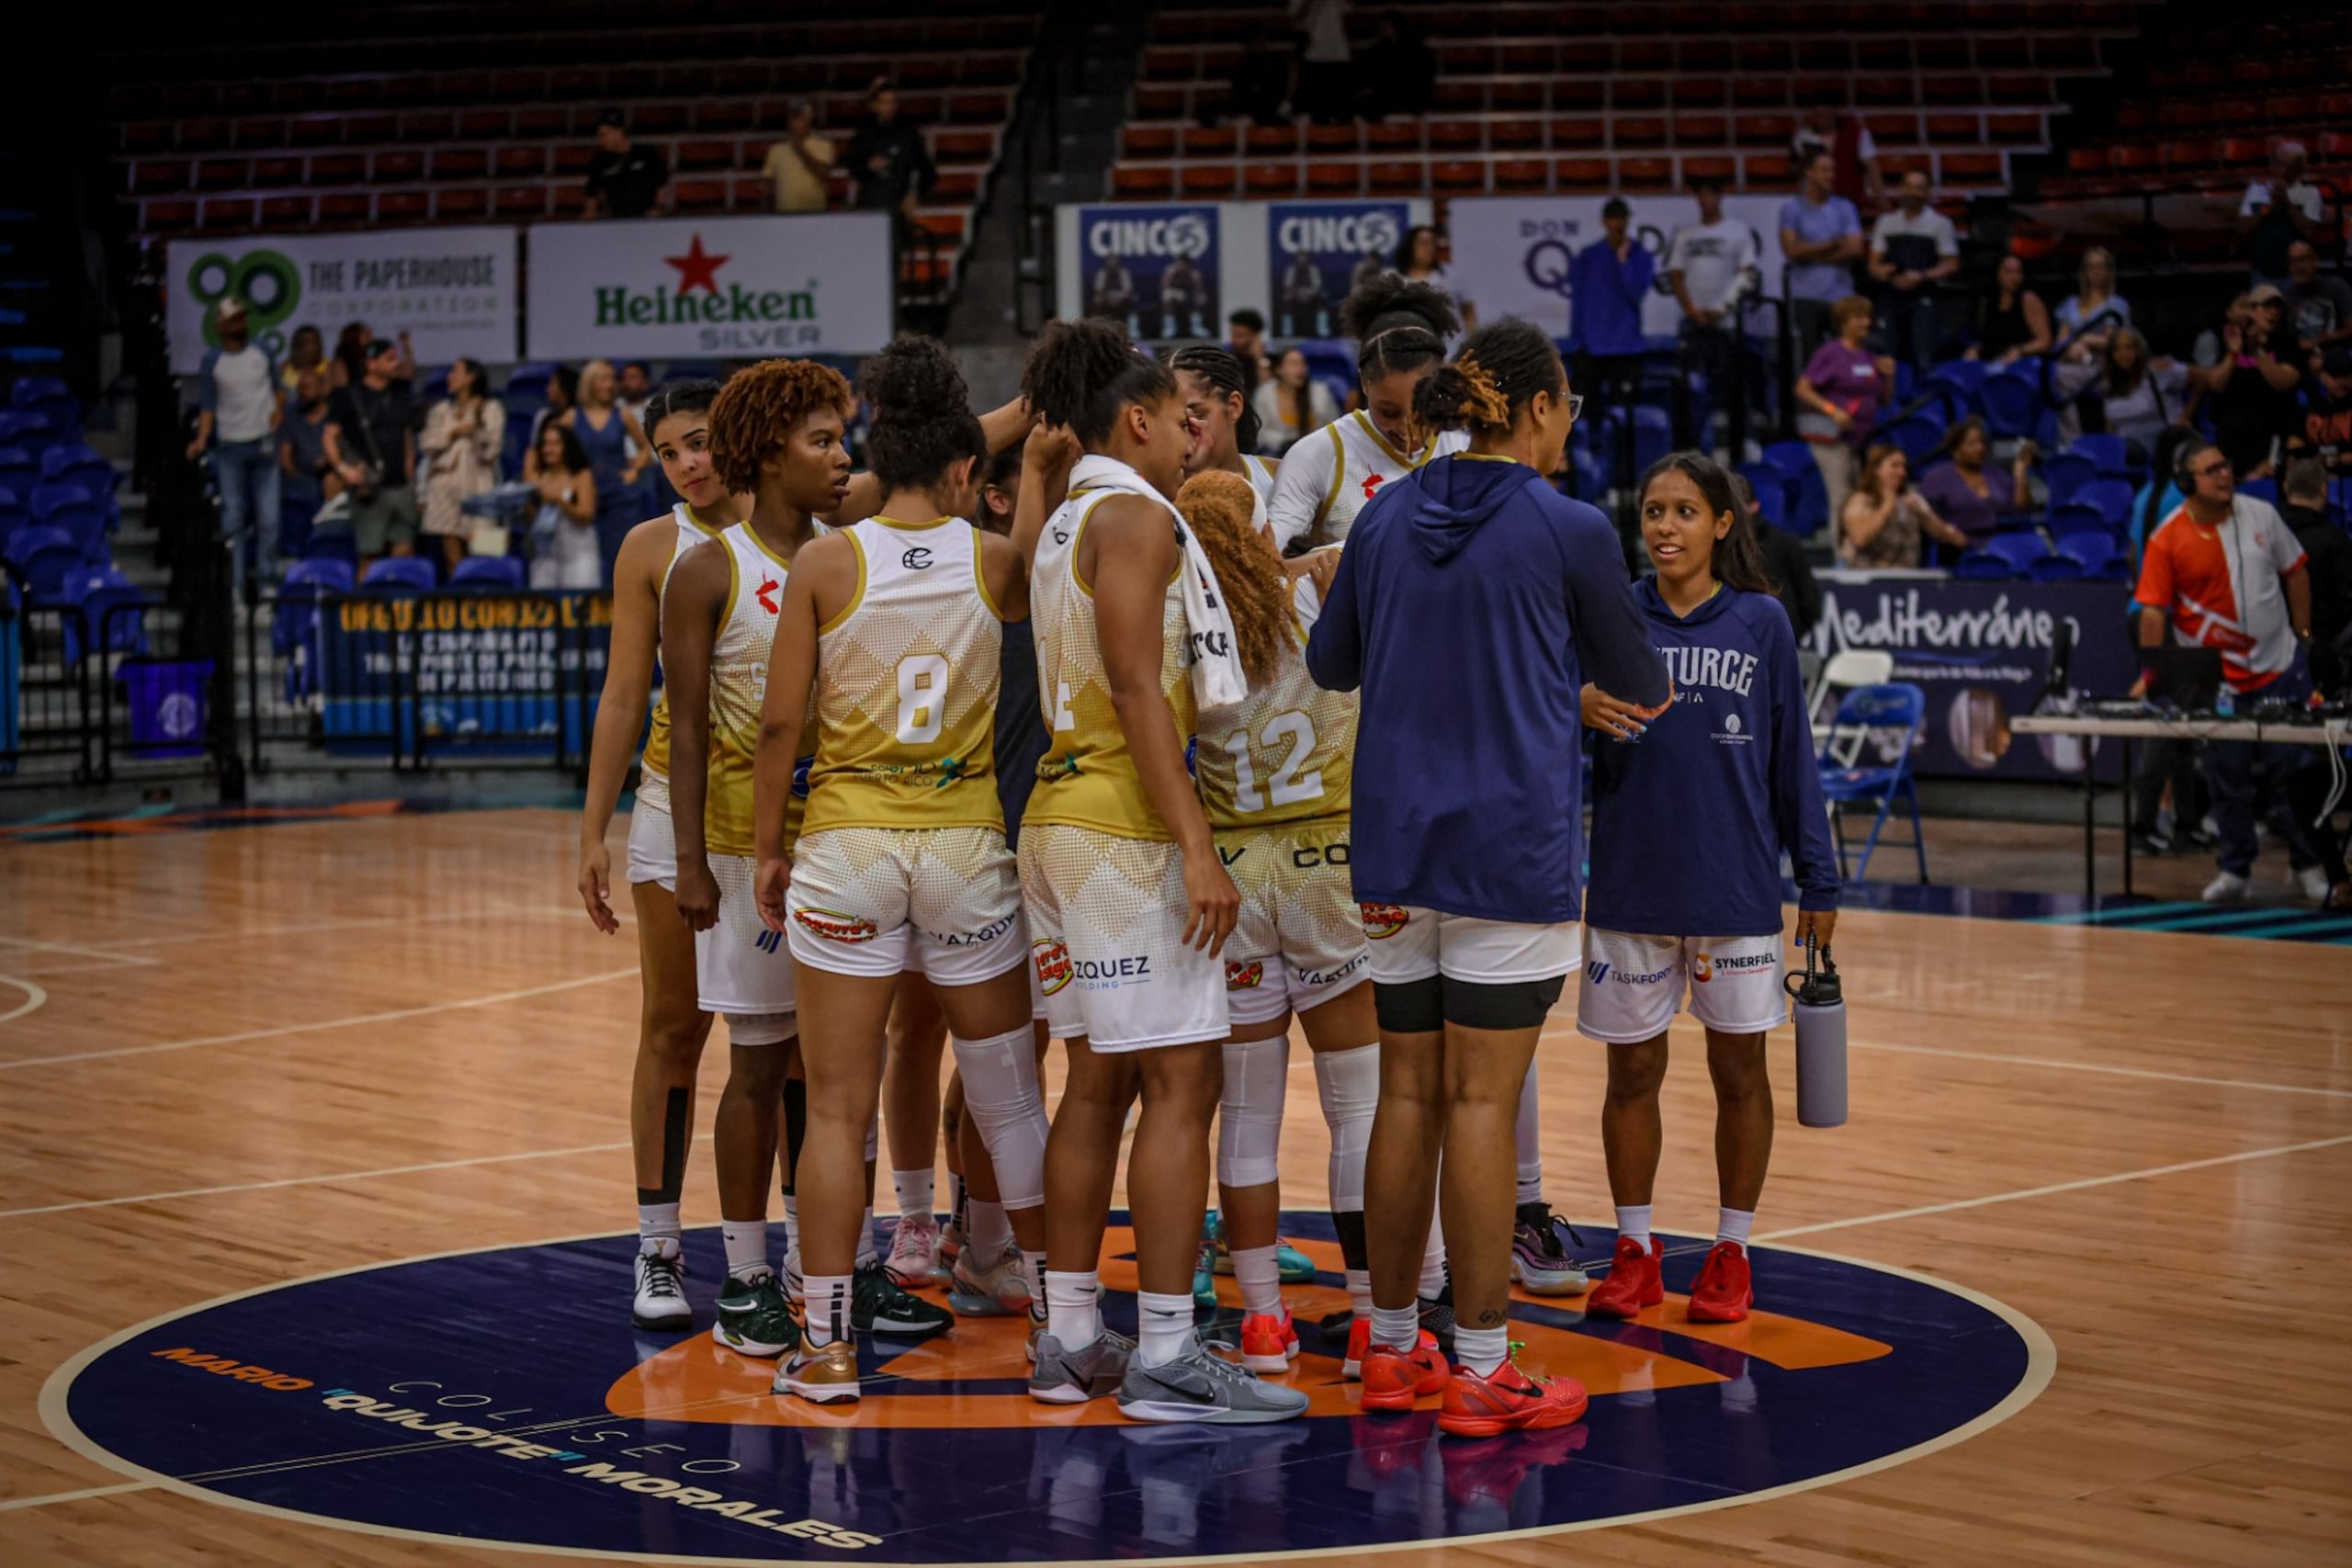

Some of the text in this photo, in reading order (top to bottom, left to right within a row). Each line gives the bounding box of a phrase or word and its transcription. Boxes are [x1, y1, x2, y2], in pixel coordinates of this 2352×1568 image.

[1520, 220, 1579, 236] DON
[310, 254, 495, 293] THE PAPERHOUSE
[594, 284, 820, 327] Heineken
[698, 325, 821, 352] SILVER
[1657, 646, 1758, 698] TURCE
[896, 653, 948, 745] 8
[1224, 709, 1325, 814] 12
[1610, 964, 1674, 985] TASKFORC
[150, 1347, 315, 1392] MARIO
[562, 1461, 885, 1550] MORALES
